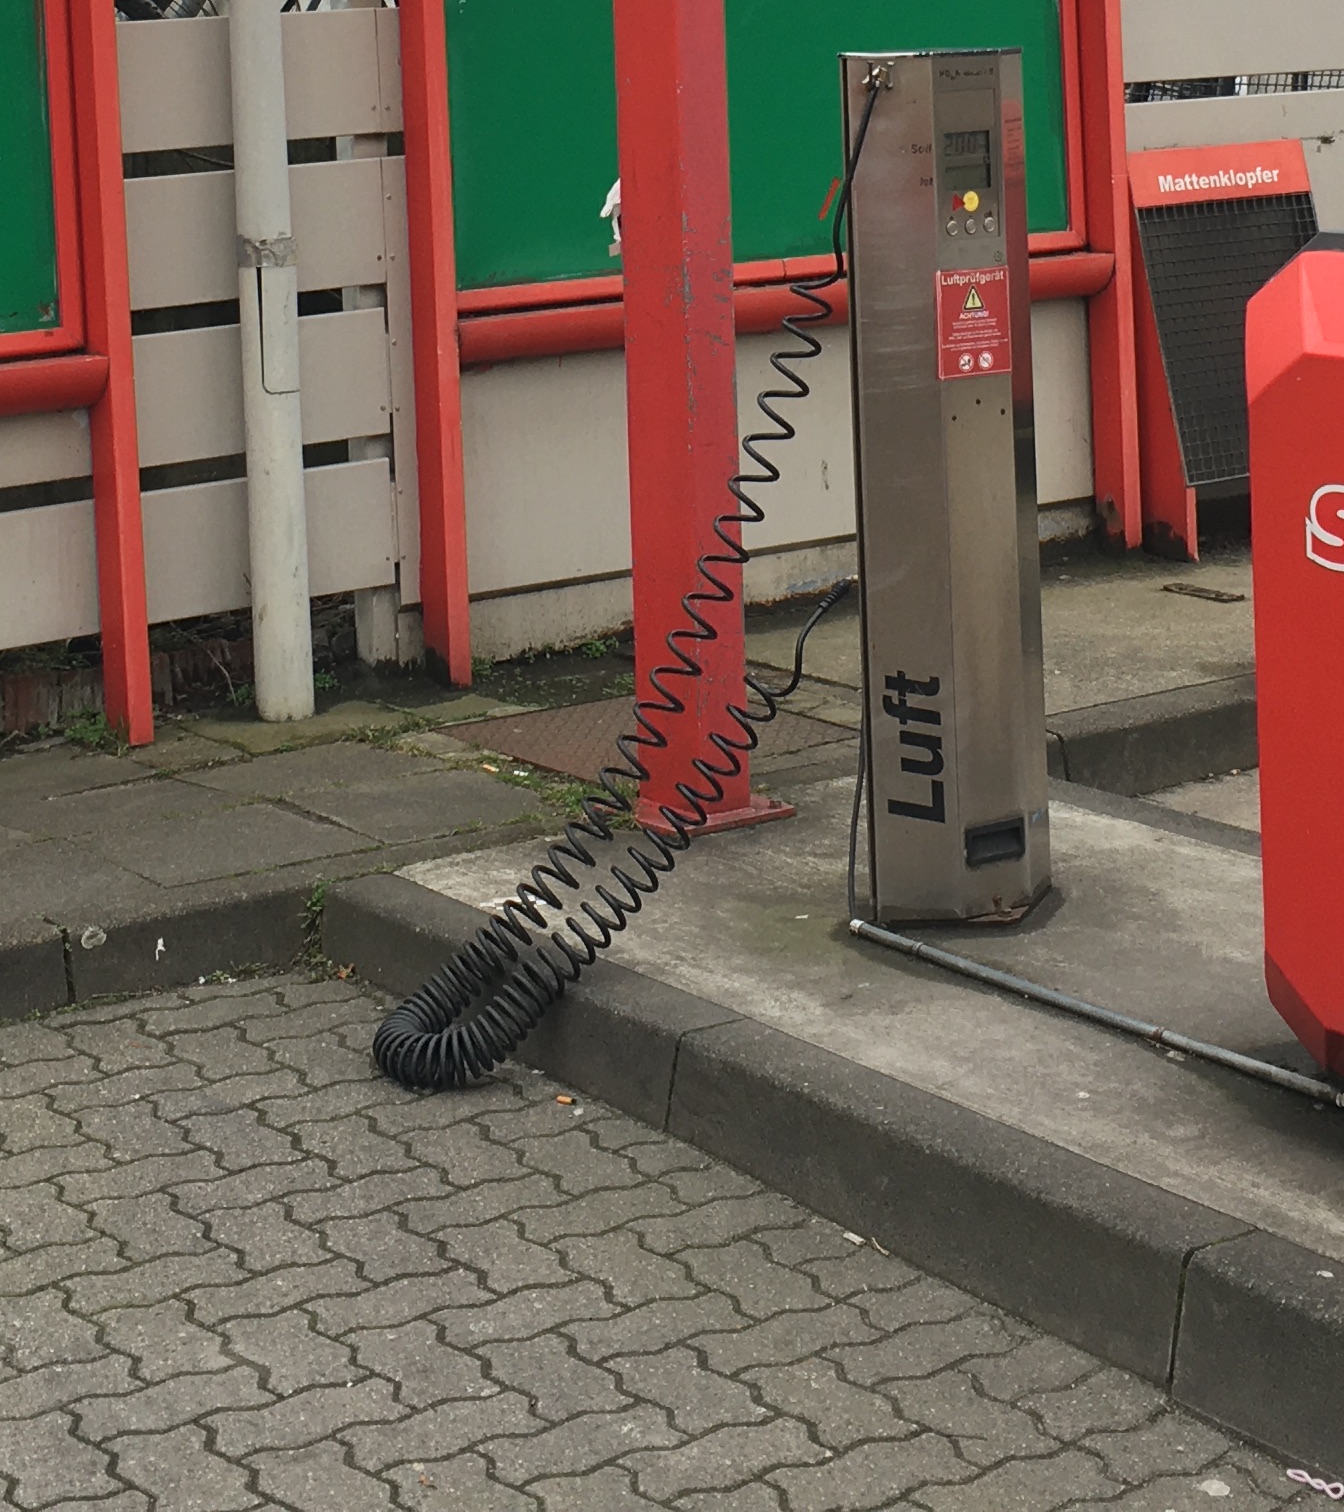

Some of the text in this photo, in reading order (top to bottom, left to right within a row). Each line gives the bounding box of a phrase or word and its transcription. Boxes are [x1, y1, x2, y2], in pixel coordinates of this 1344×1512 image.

[1157, 166, 1280, 193] Mattenklopfer
[941, 270, 1004, 286] Luftprüfgerät
[882, 669, 946, 824] Luft
